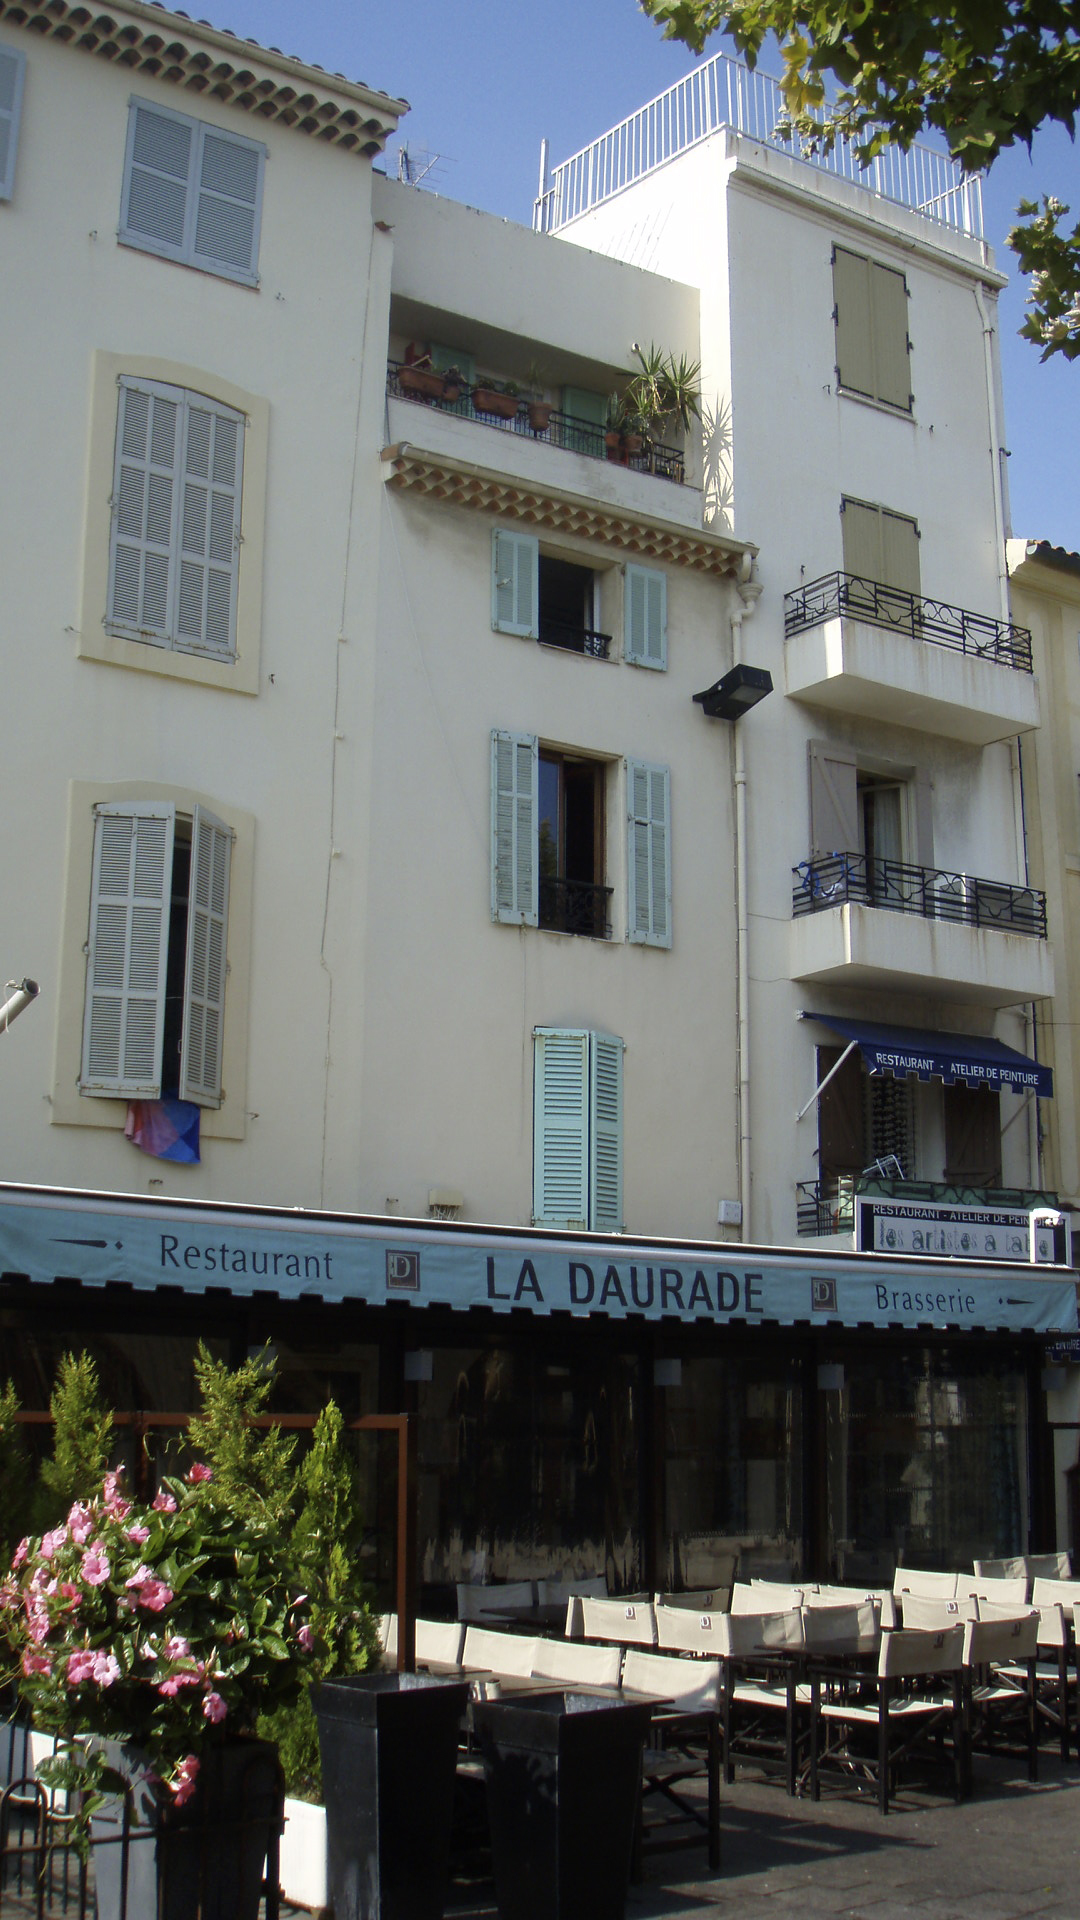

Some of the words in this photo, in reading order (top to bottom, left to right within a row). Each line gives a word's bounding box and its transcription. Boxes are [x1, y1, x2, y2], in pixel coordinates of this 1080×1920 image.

[876, 1053, 935, 1071] RESTAURANT
[950, 1062, 985, 1078] ATELIER
[986, 1066, 998, 1079] DE
[999, 1068, 1039, 1085] PEINTURE
[872, 1204, 940, 1220] RESTAURANT
[950, 1211, 990, 1223] ATELIER
[993, 1214, 1006, 1224] DE
[160, 1234, 333, 1280] Restaurant
[486, 1256, 544, 1302] LA
[568, 1261, 764, 1313] DAURADE
[875, 1284, 976, 1313] Brasserie
